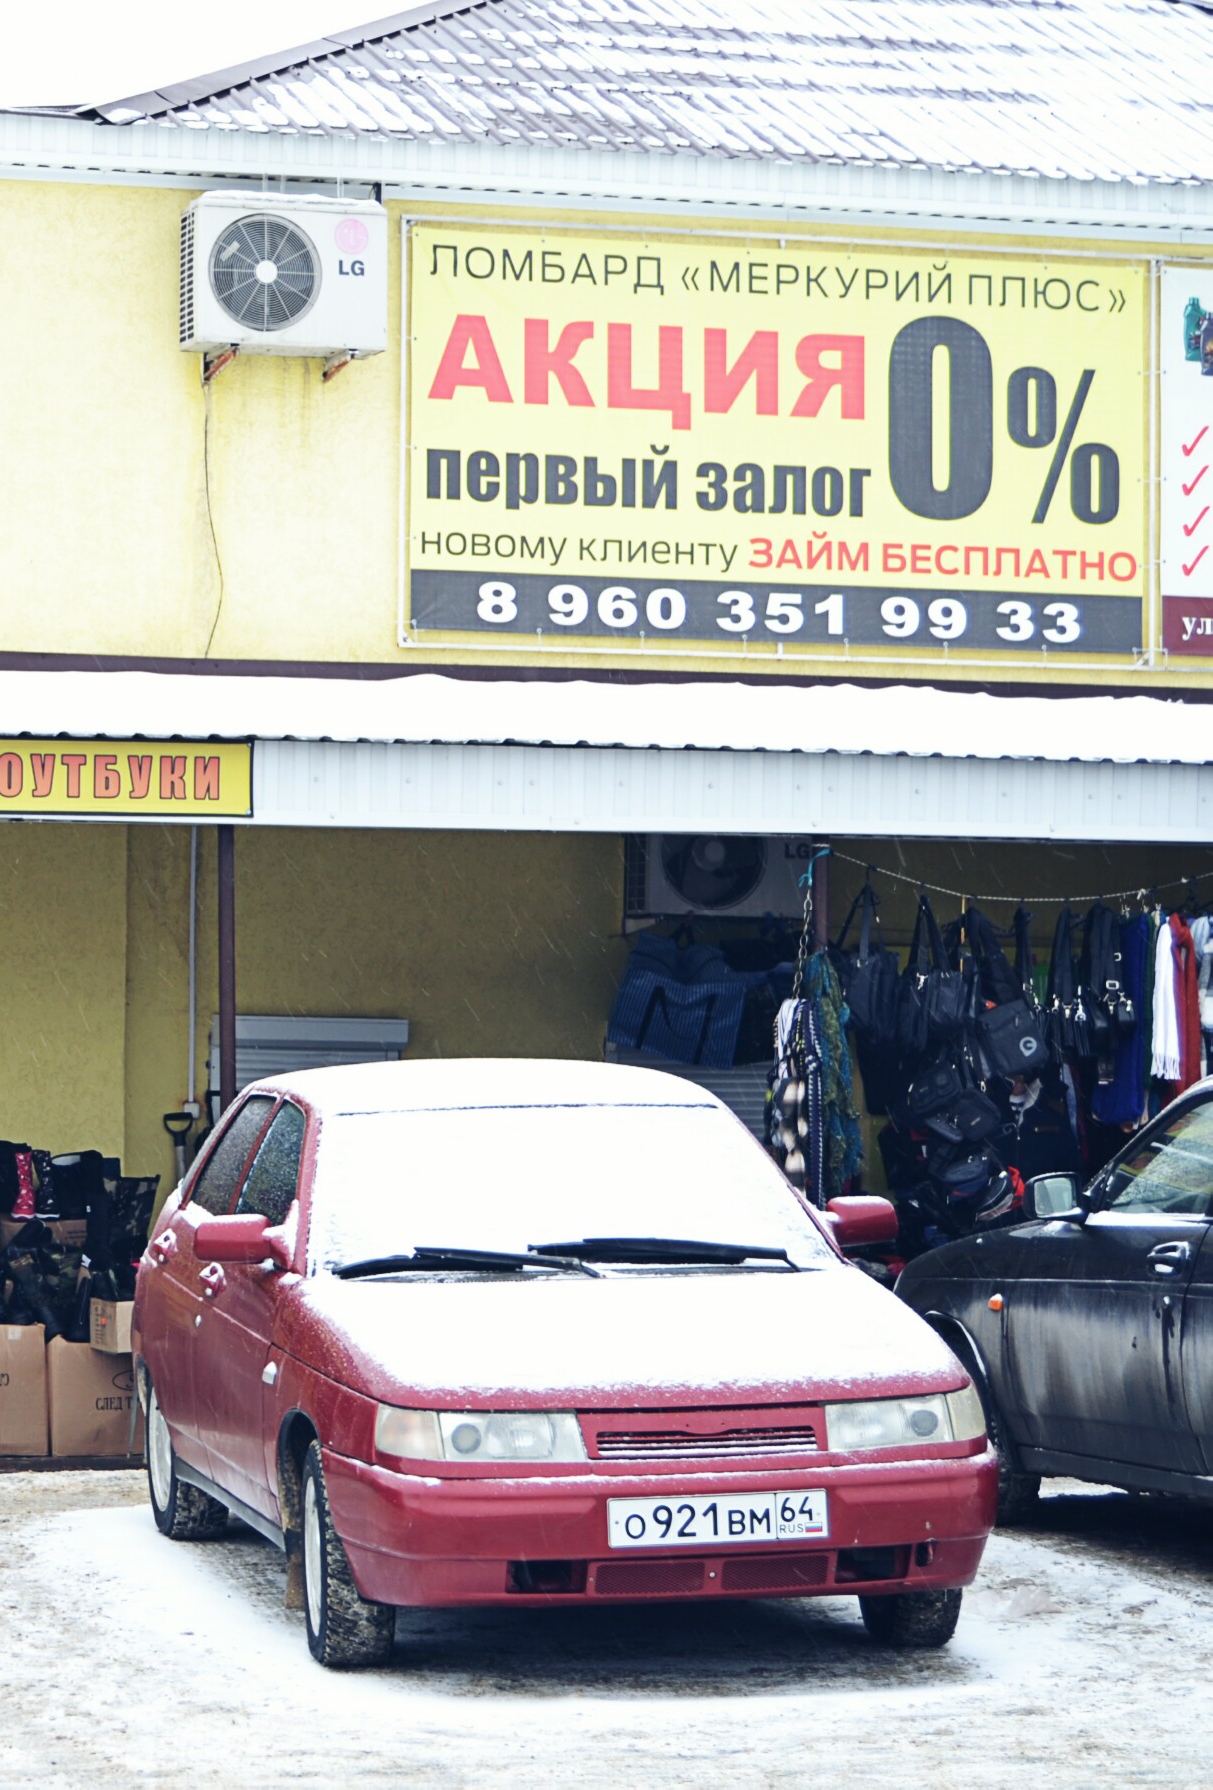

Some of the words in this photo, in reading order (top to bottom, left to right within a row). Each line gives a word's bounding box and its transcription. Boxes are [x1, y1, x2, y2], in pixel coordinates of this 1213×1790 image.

[338, 260, 365, 276] LG
[430, 244, 665, 296] ЛОМБАРД
[681, 260, 953, 305] «МЕРКУРИЙ
[968, 274, 1127, 314] ПЛЮС»
[427, 313, 866, 431] АКЦИЯ
[888, 315, 1121, 525] 0%
[426, 444, 678, 510] первый
[695, 462, 872, 516] залог
[421, 531, 567, 566] новому
[579, 538, 738, 573] клиенту
[748, 531, 871, 573] ЗАЙМ
[881, 543, 1138, 583] БЕСПЛАТНО
[476, 581, 518, 624] 8
[548, 584, 687, 631] 960
[716, 590, 844, 636] 351
[880, 596, 968, 640] 99
[995, 601, 1082, 644] 33
[784, 843, 810, 859] LG
[95, 1396, 122, 1412] СЛЕД
[779, 1523, 804, 1534] RUS
[780, 1496, 814, 1523] 64
